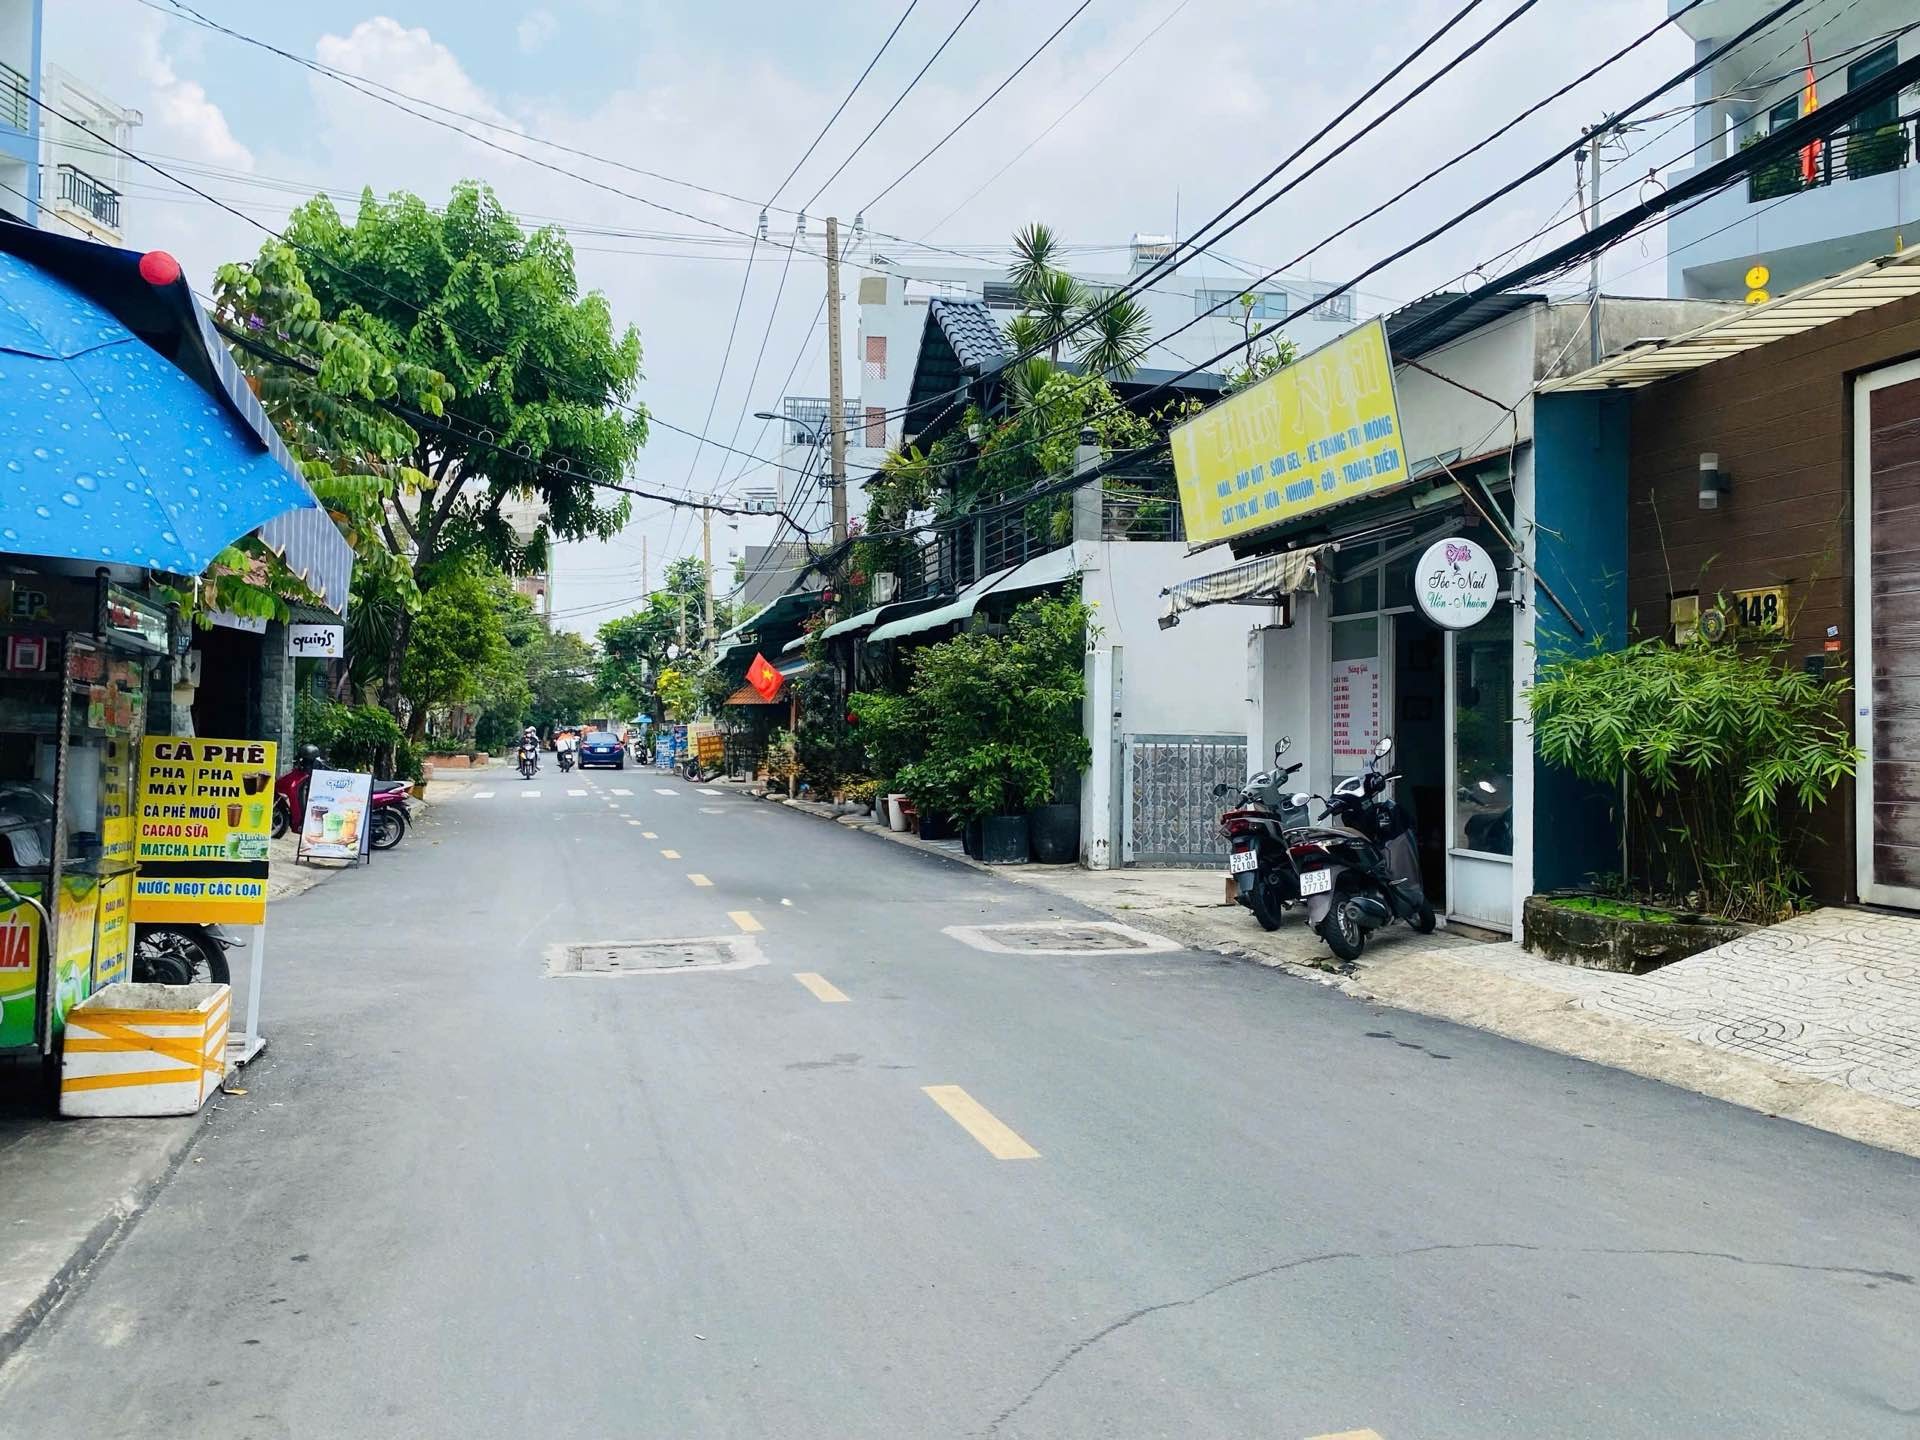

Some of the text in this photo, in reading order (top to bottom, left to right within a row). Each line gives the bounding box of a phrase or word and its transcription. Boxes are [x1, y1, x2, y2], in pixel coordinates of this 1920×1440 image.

[1286, 451, 1302, 471] GEL
[1319, 432, 1346, 460] TRANG
[1342, 458, 1372, 484] TRANG
[1457, 570, 1487, 589] Nail
[1740, 593, 1777, 627] 148
[203, 744, 264, 764] PHÊ
[150, 766, 185, 779] PHA
[198, 769, 233, 781] PHA
[149, 782, 187, 796] MÁY
[197, 785, 240, 797] PHIN
[143, 824, 209, 838] CACAO SỮA
[141, 843, 189, 857] MATCHA
[193, 844, 226, 857] LATTE
[138, 881, 261, 898] NƯỚC NGỌT CÁC LOẠI
